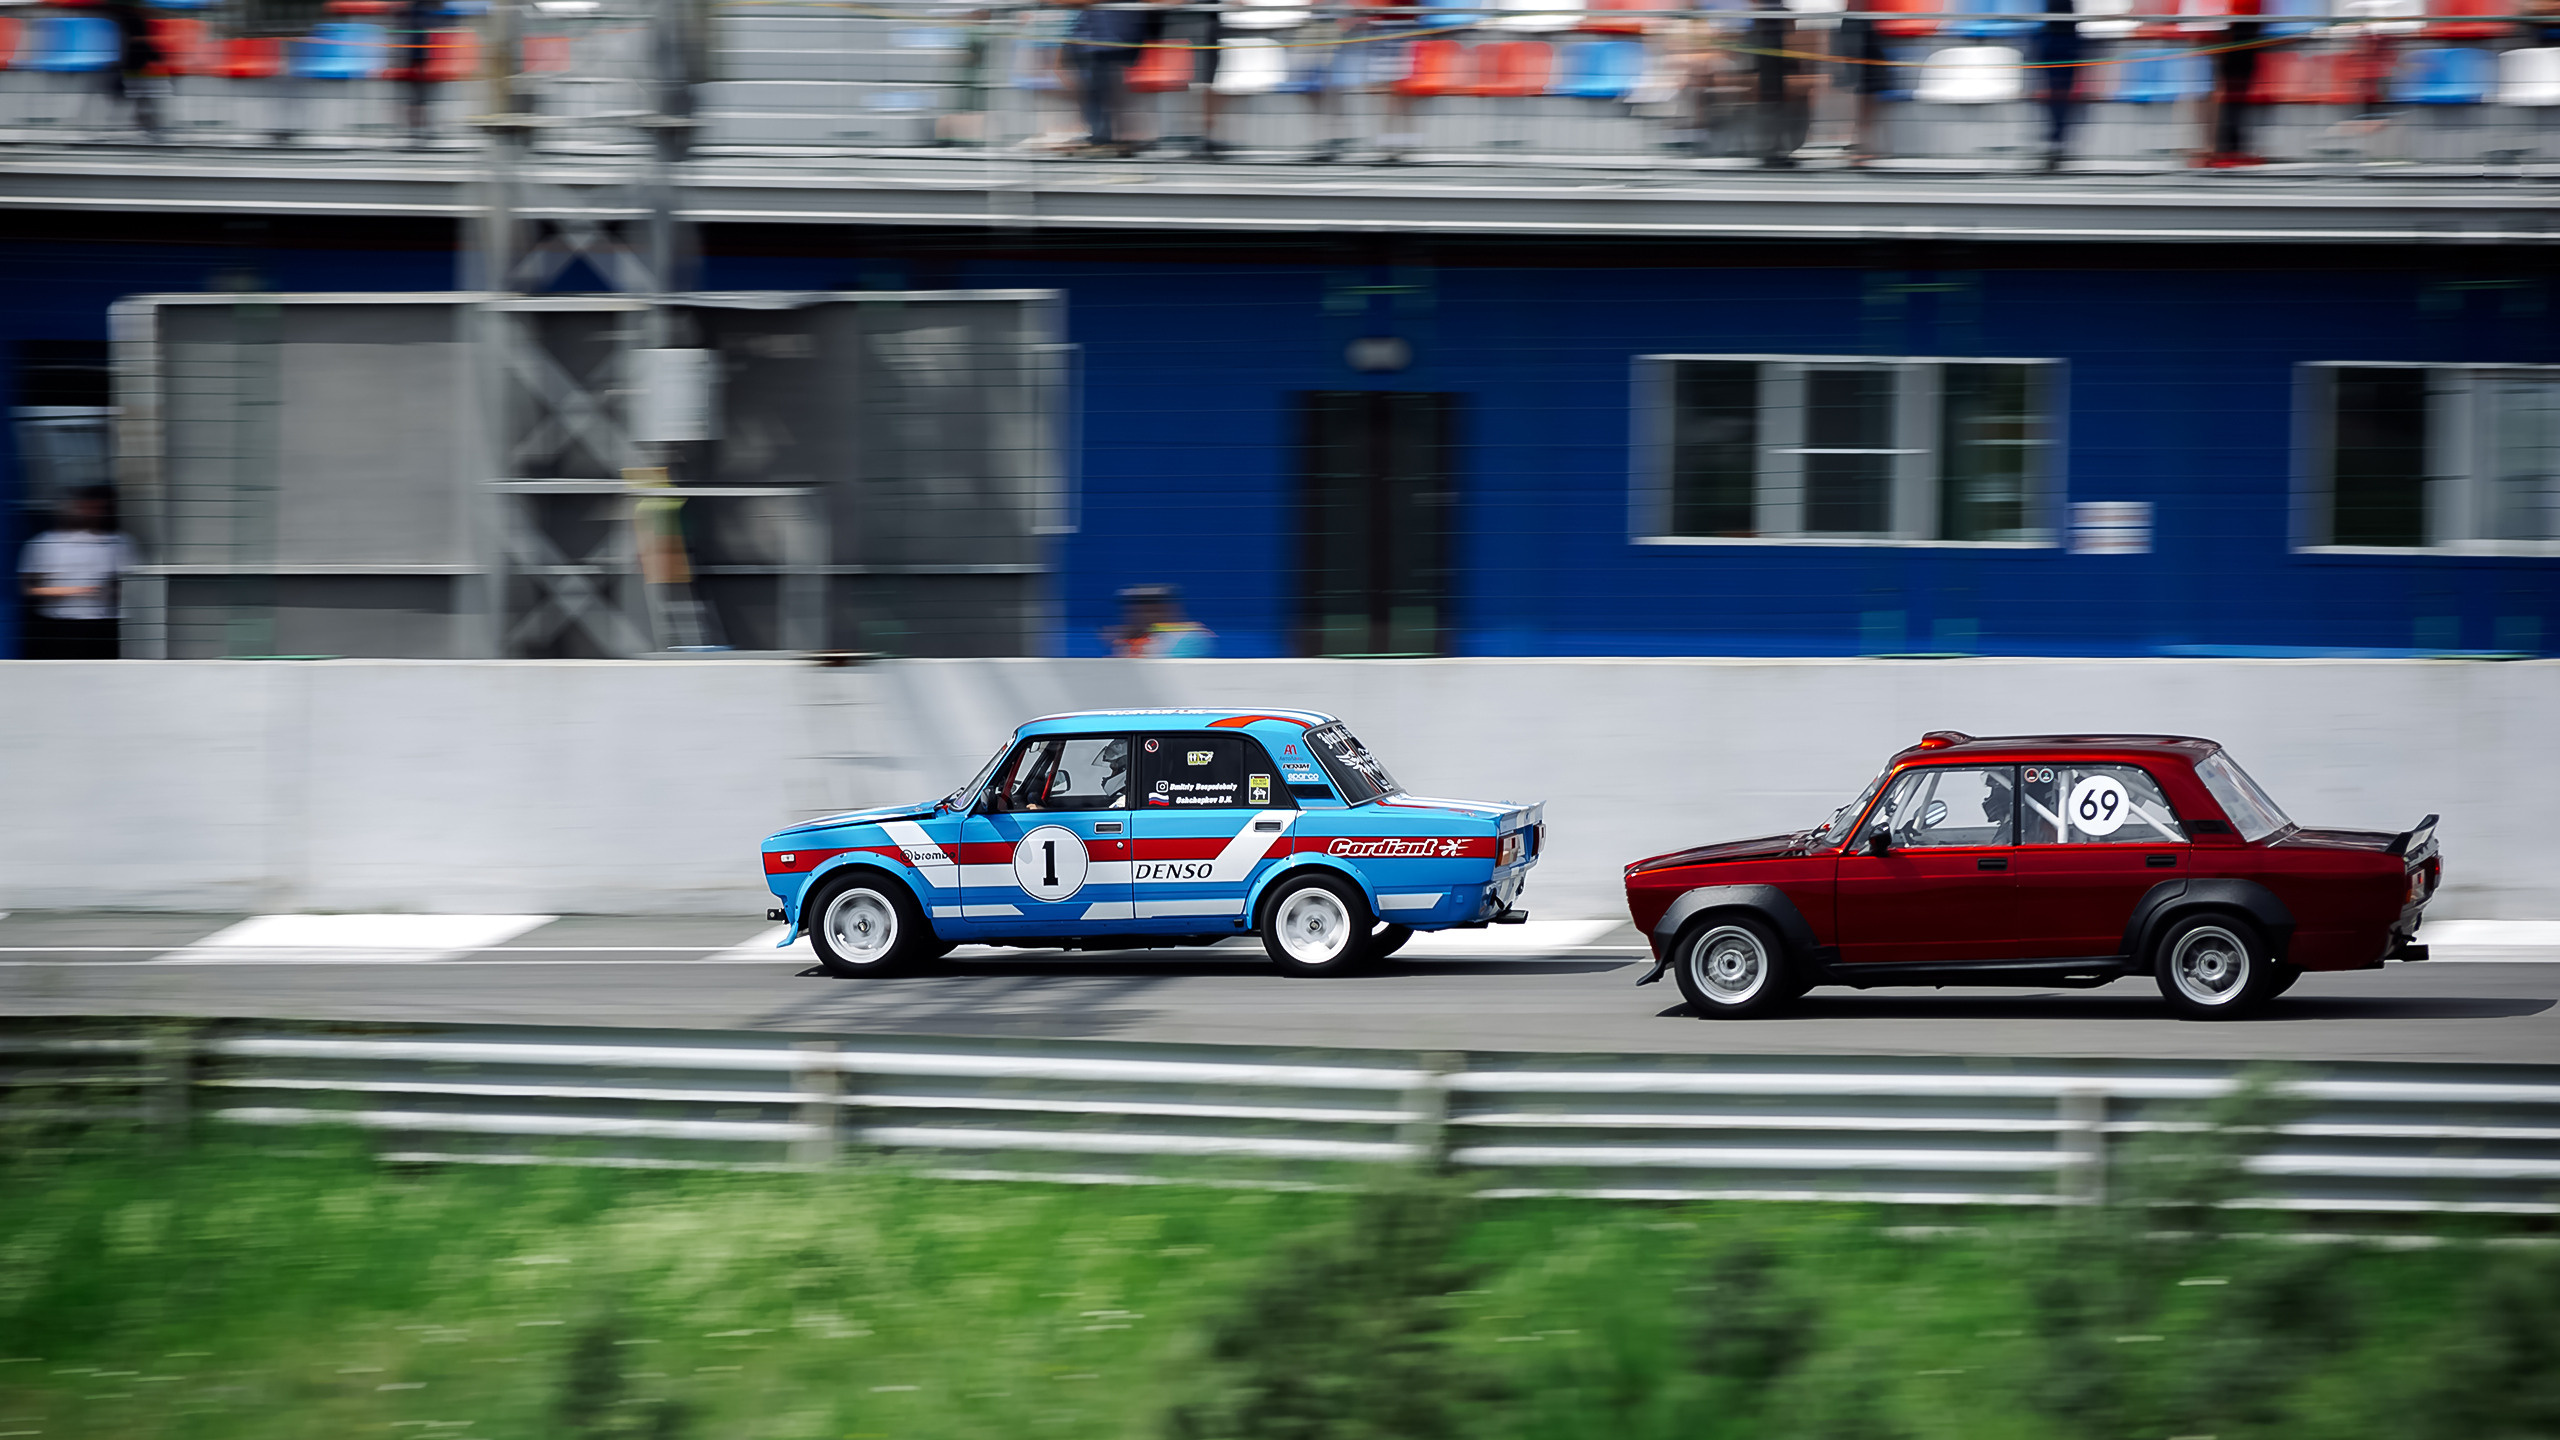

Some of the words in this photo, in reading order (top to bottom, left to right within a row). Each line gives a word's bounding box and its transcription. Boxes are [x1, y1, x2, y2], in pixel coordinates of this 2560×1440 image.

[1287, 773, 1319, 782] sparco
[1170, 783, 1194, 791] Dmitriy
[2080, 789, 2119, 821] 69
[1327, 838, 1438, 857] Cordiant
[1042, 841, 1059, 886] 1
[1135, 863, 1213, 879] DENSO
